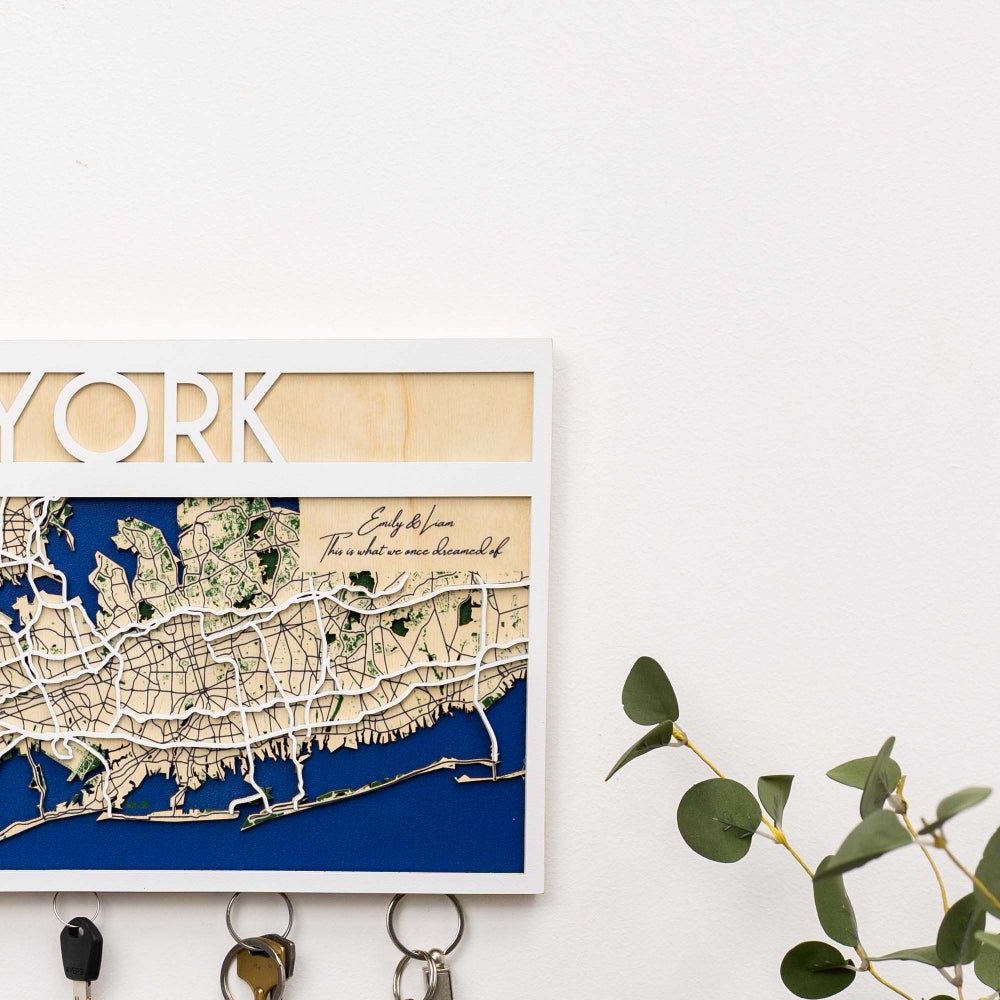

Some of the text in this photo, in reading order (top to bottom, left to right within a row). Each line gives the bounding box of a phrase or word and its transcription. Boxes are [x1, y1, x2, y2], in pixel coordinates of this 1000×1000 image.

[357, 504, 455, 538] Emily & Liam
[319, 532, 510, 563] This is what we once dreamed of
